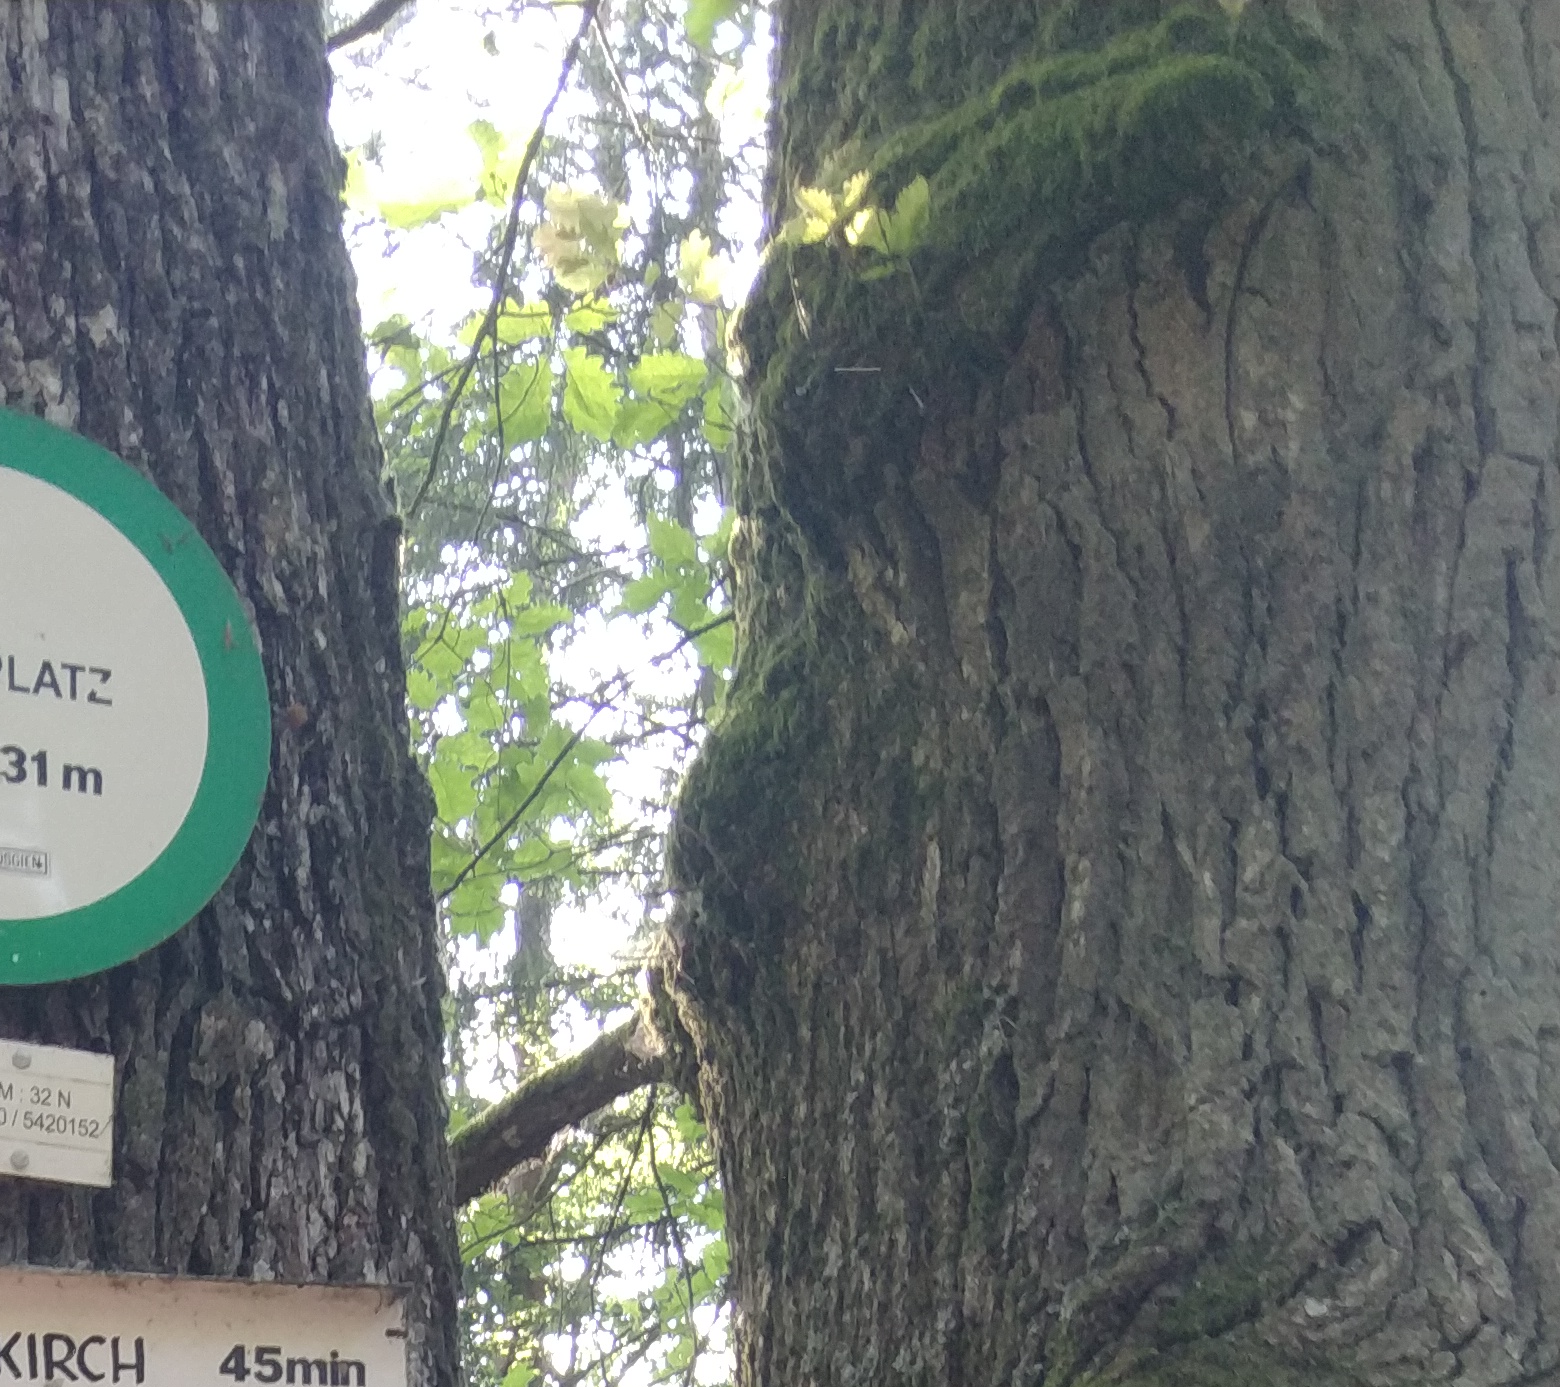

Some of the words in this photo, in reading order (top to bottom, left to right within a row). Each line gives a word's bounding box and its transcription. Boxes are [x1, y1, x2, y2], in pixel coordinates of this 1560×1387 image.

[30, 1086, 52, 1107] 32
[57, 1090, 71, 1109] N
[22, 1111, 100, 1139] 5420152
